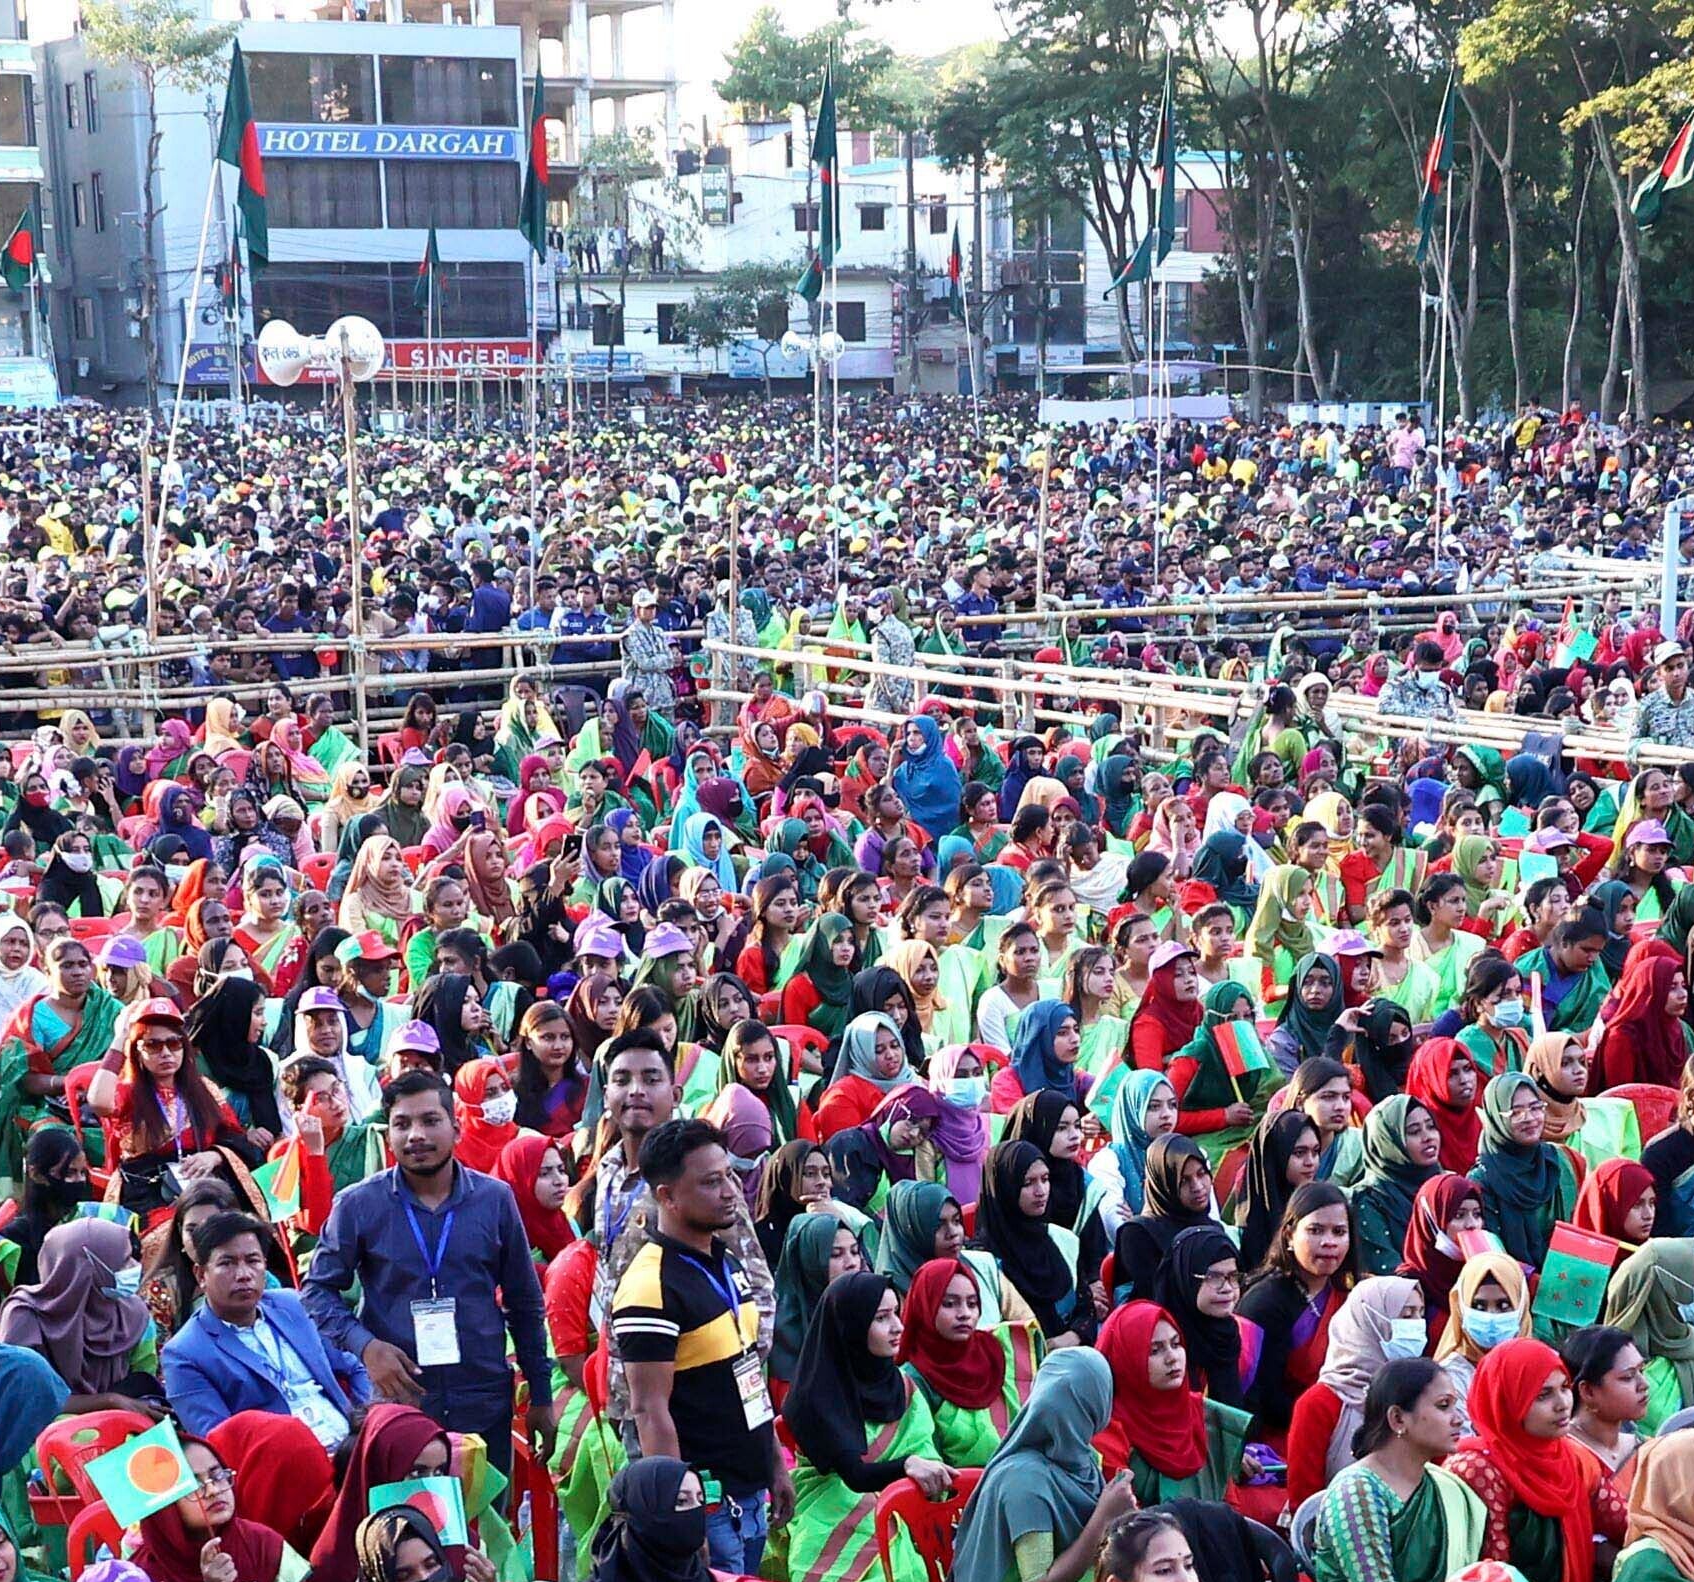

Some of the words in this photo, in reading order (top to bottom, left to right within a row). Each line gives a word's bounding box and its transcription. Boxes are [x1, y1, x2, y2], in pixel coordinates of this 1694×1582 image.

[264, 130, 367, 152] HOTEL
[375, 131, 506, 154] DARGAH
[410, 349, 507, 367] SINGER
